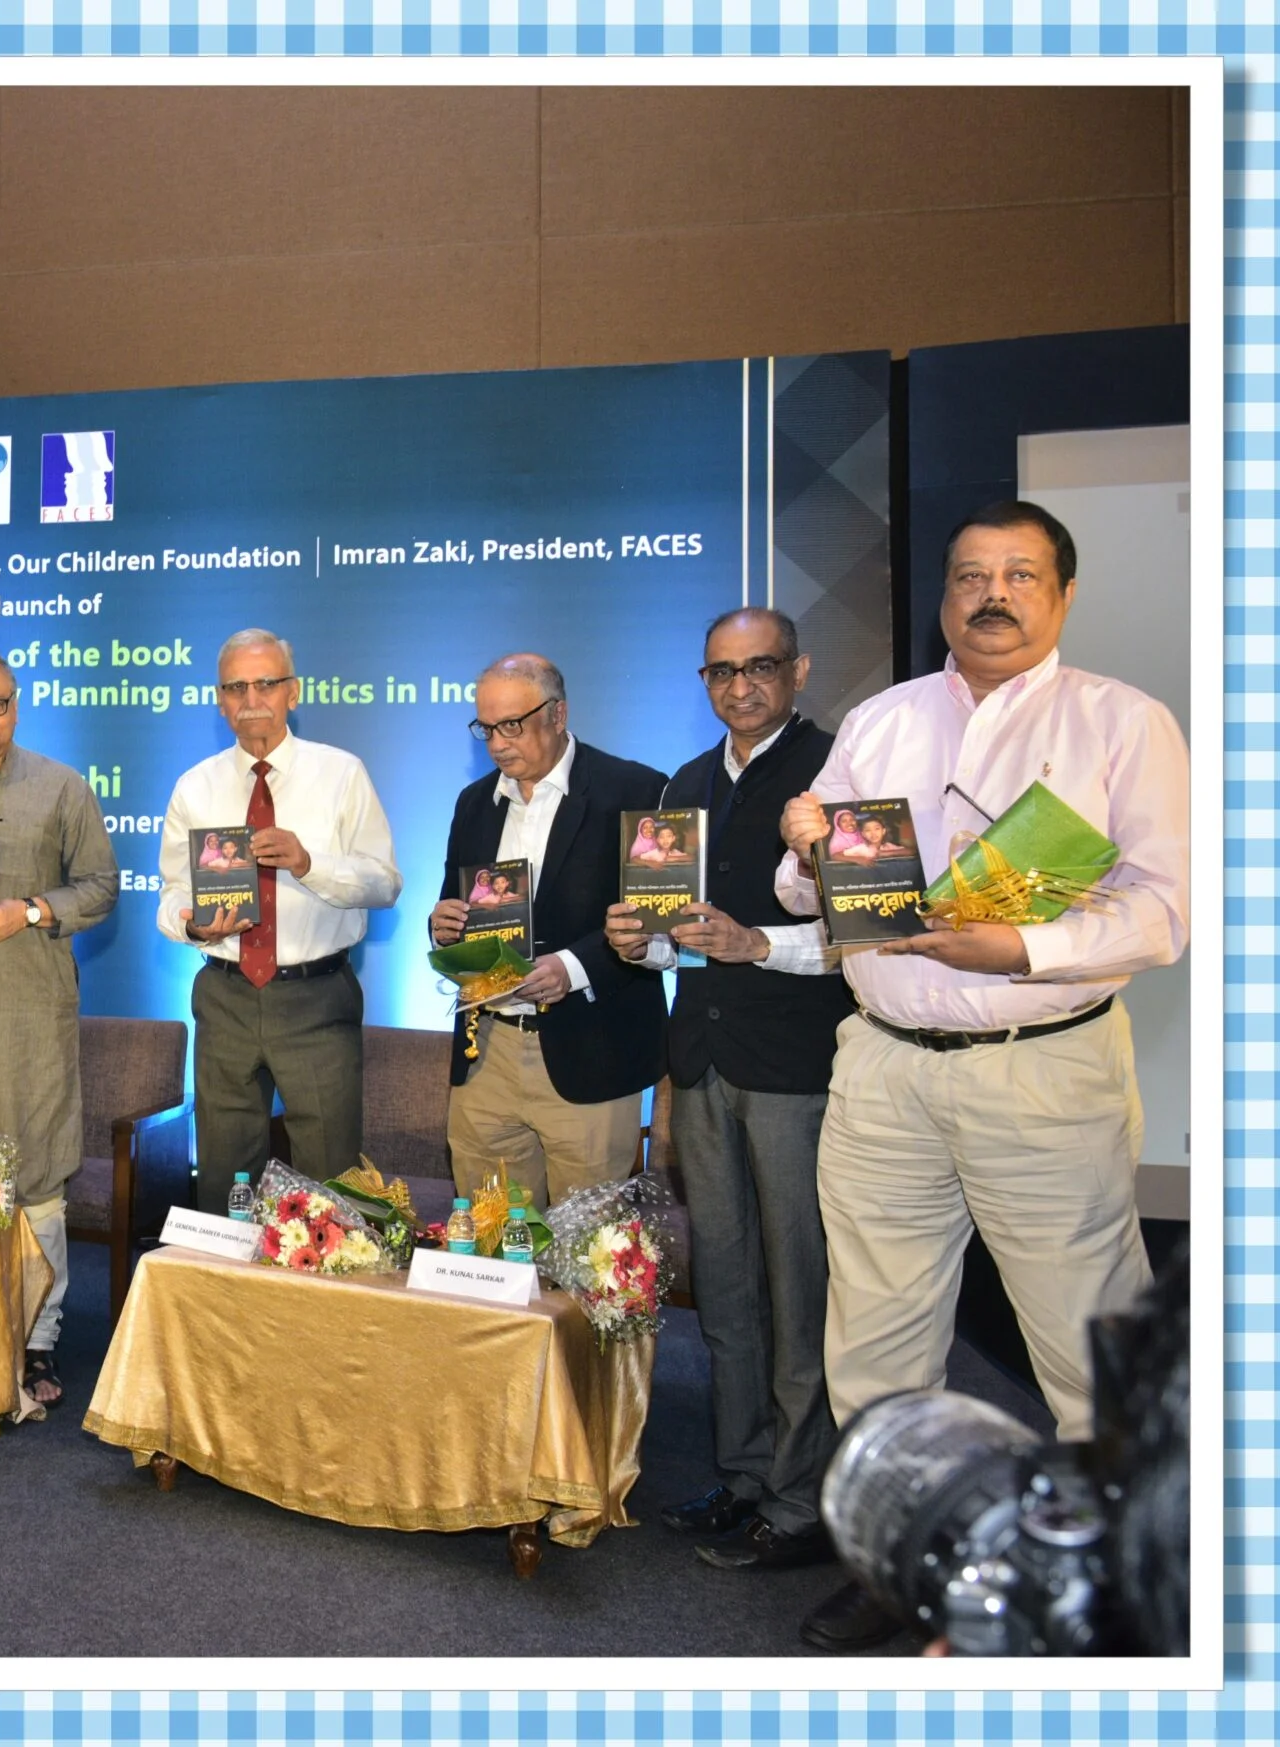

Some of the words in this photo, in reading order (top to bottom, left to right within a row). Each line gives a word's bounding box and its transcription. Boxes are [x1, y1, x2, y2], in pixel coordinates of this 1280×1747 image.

[42, 506, 112, 522] FACES
[7, 554, 50, 575] Our
[56, 550, 155, 573] Children
[163, 547, 301, 570] Foundation
[333, 543, 406, 565] Imran
[413, 540, 474, 565] Zaki,
[483, 537, 613, 561] President,
[621, 533, 703, 557] FACES
[78, 592, 103, 615] of
[7, 640, 40, 669] of
[50, 641, 100, 668] the
[111, 638, 192, 667] book
[31, 680, 170, 713] Planning
[181, 684, 219, 705] an
[386, 675, 417, 704] in
[831, 890, 921, 919] জনপুরাণ
[436, 1267, 448, 1275] DR.
[450, 1269, 474, 1279] KUNAL
[476, 1273, 505, 1283] SARKAR
